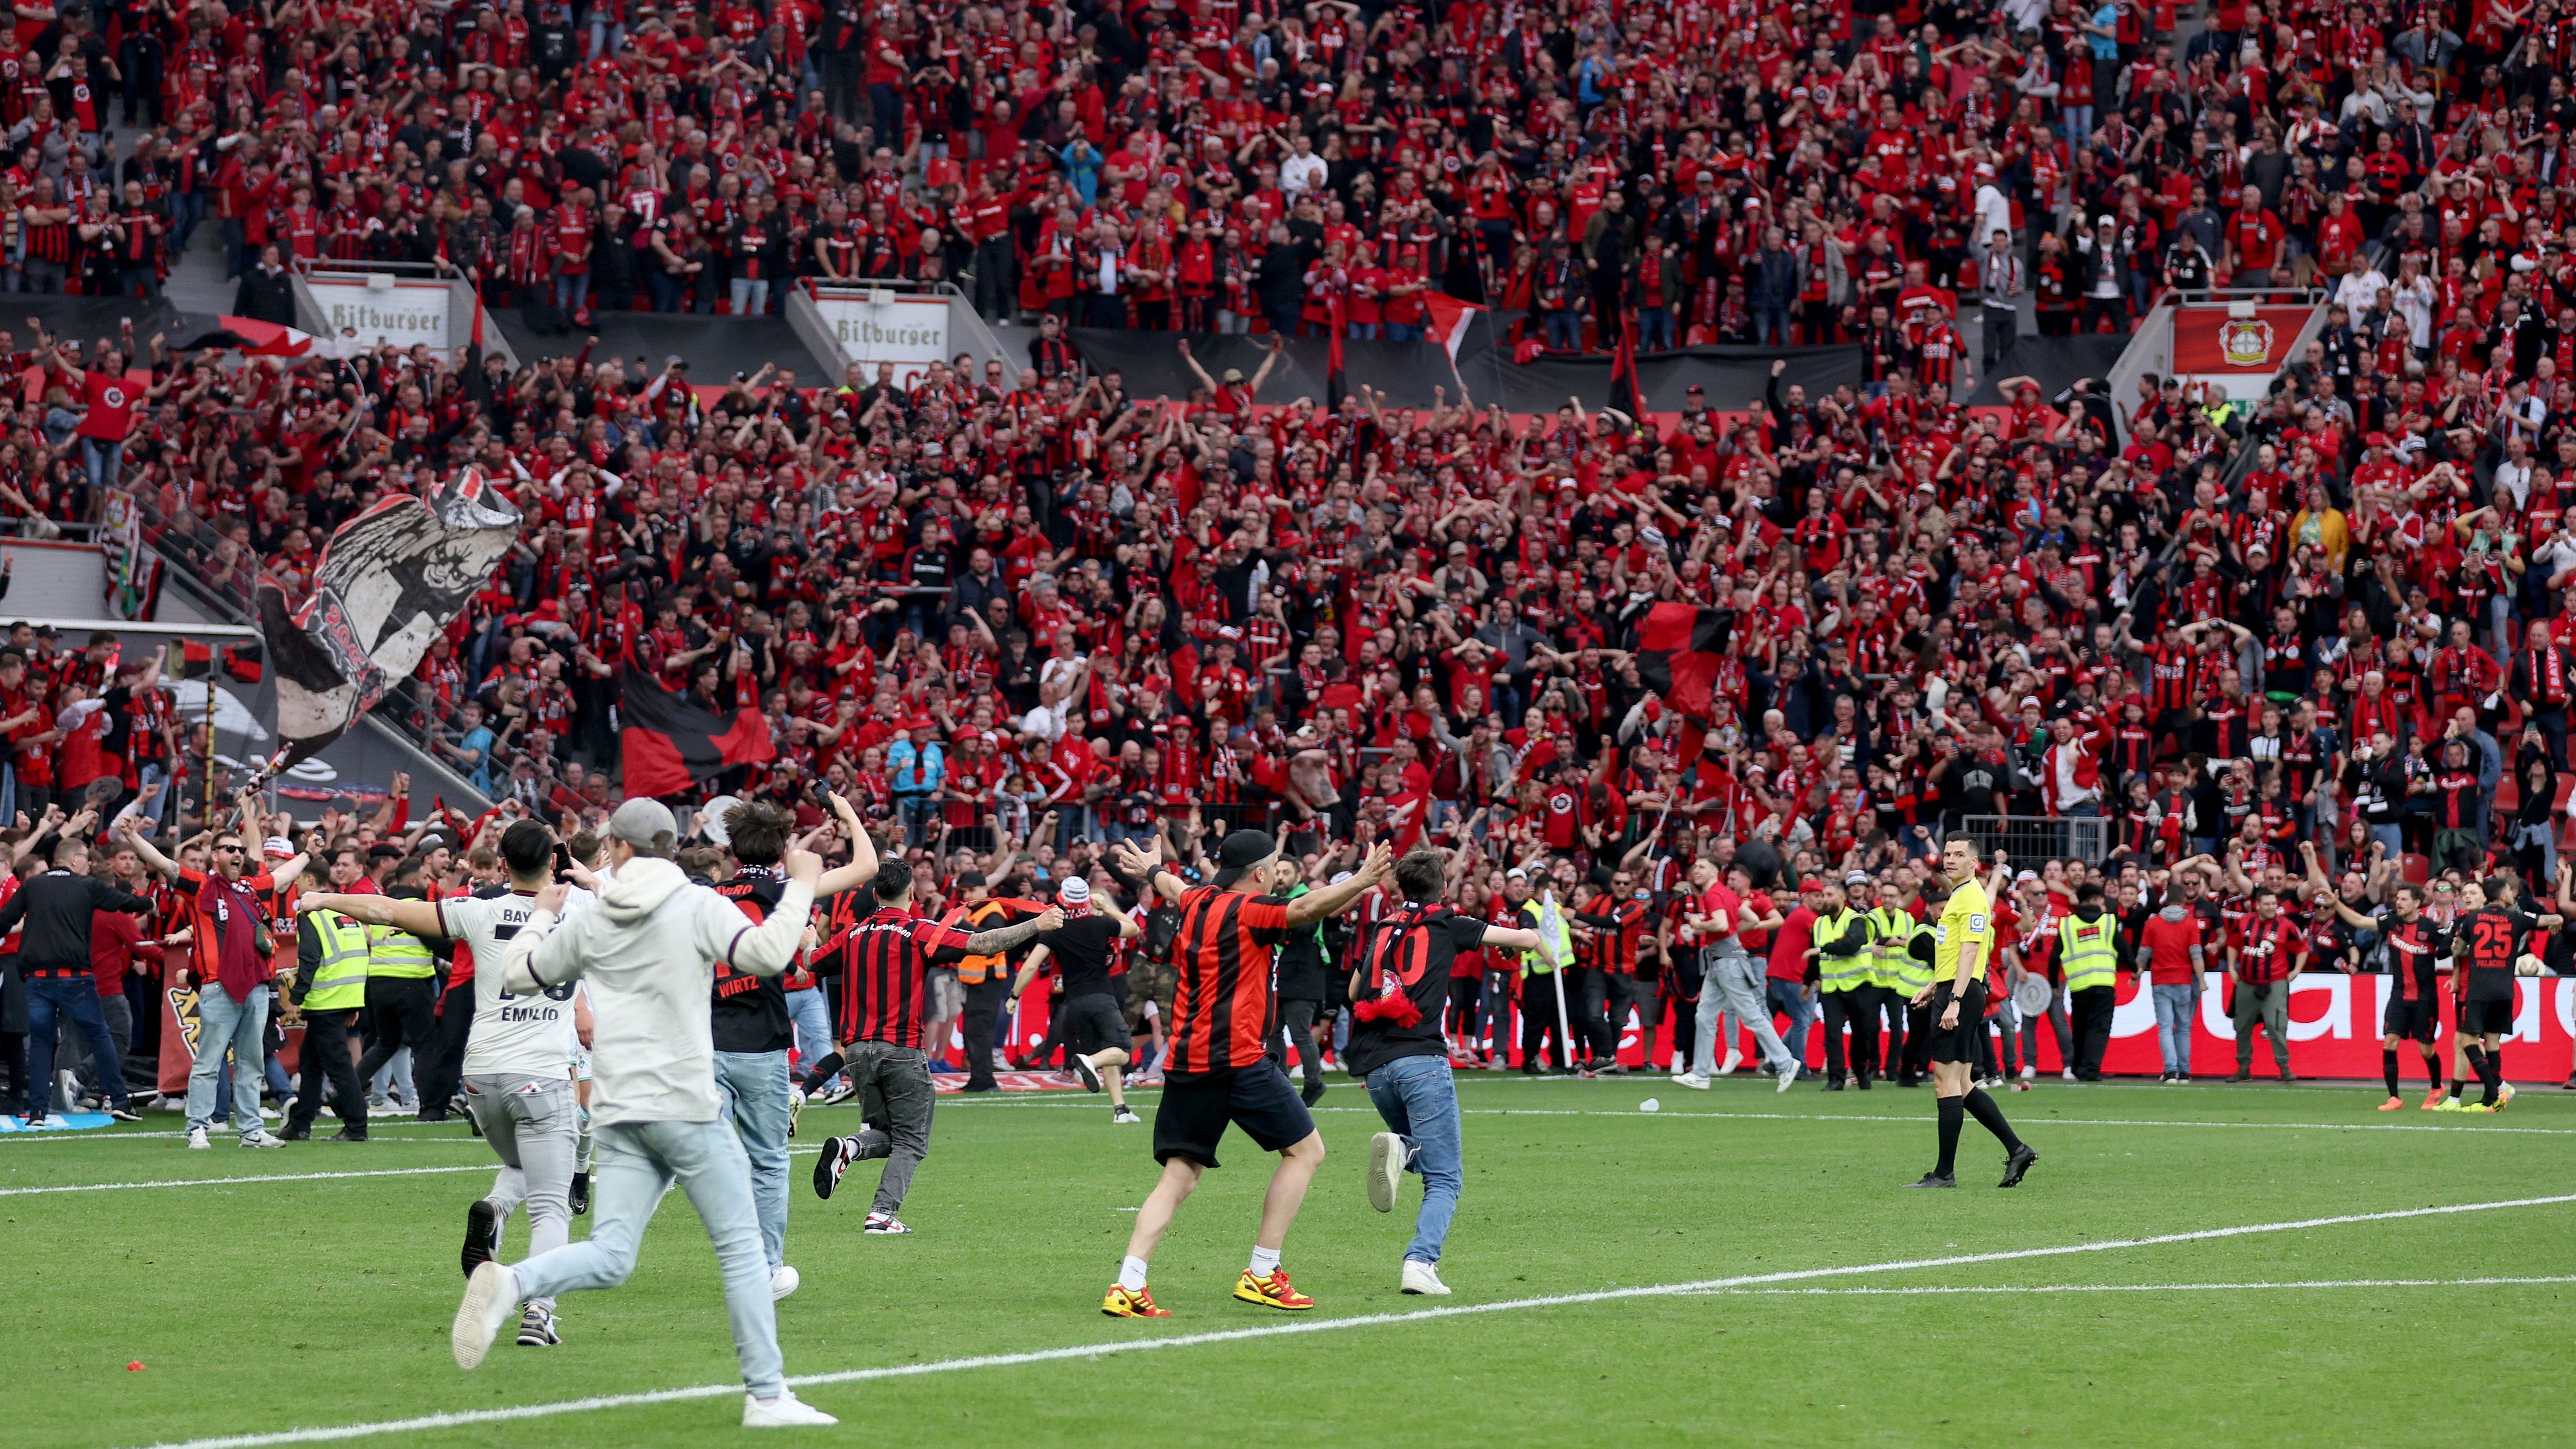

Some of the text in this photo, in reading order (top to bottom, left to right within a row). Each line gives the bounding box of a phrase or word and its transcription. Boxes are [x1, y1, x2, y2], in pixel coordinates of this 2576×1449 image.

[333, 305, 440, 330] Bitburger
[838, 320, 940, 345] Bitburger
[850, 923, 912, 939] Bayer Leverkusen
[2473, 922, 2513, 958] 25
[1371, 924, 1430, 988] 10
[2391, 934, 2429, 955] Barmenia
[719, 975, 759, 998] WIRTZ
[502, 1006, 558, 1022] EMILIO
